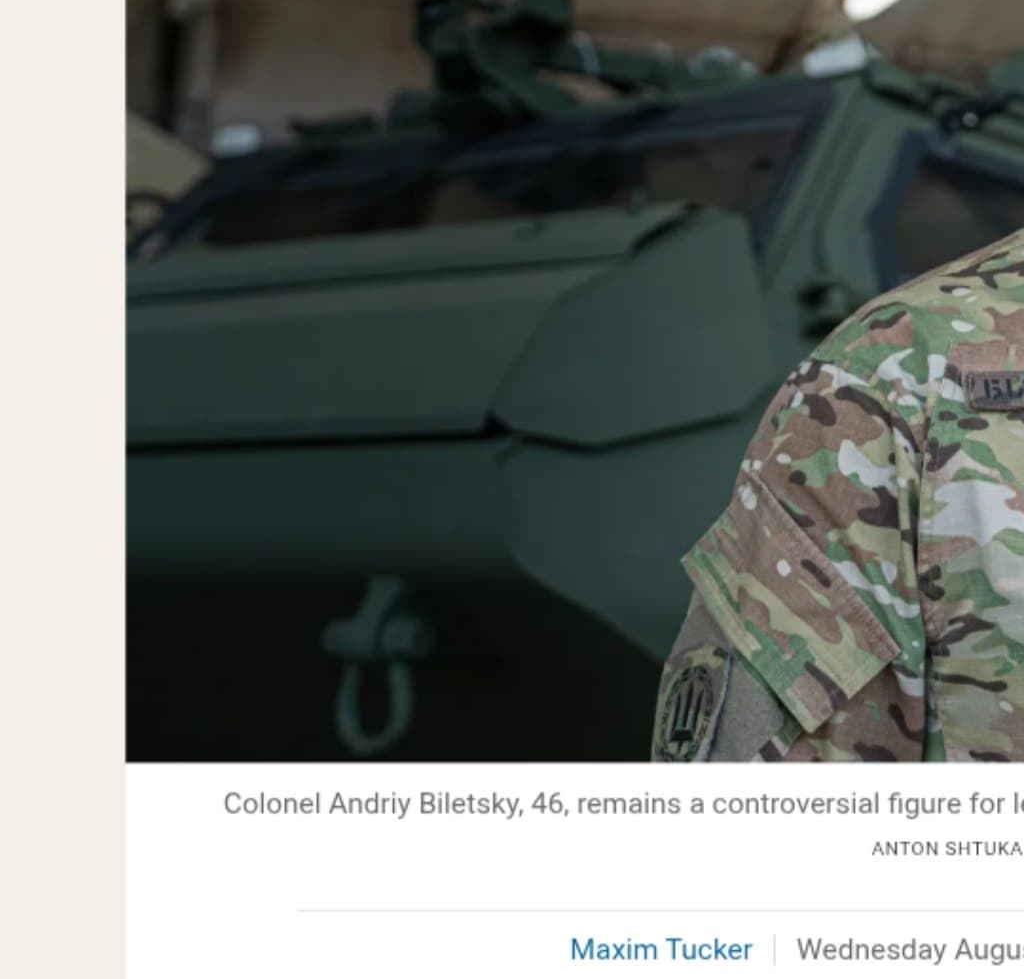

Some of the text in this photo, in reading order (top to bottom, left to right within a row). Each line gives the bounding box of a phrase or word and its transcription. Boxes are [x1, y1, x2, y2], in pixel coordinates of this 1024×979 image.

[224, 792, 320, 814] Colonel
[329, 792, 410, 819] Andriy
[421, 792, 523, 819] Biletsky,
[531, 792, 568, 818] 46,
[578, 792, 681, 814] remains
[691, 798, 704, 814] a
[713, 792, 878, 814] controversial
[888, 792, 961, 819] figure
[970, 792, 1005, 814] for
[872, 841, 938, 856] ANTON
[946, 841, 1022, 856] SHTUKA
[571, 938, 753, 960] Maxim Tucker
[797, 938, 947, 966] Wednesday
